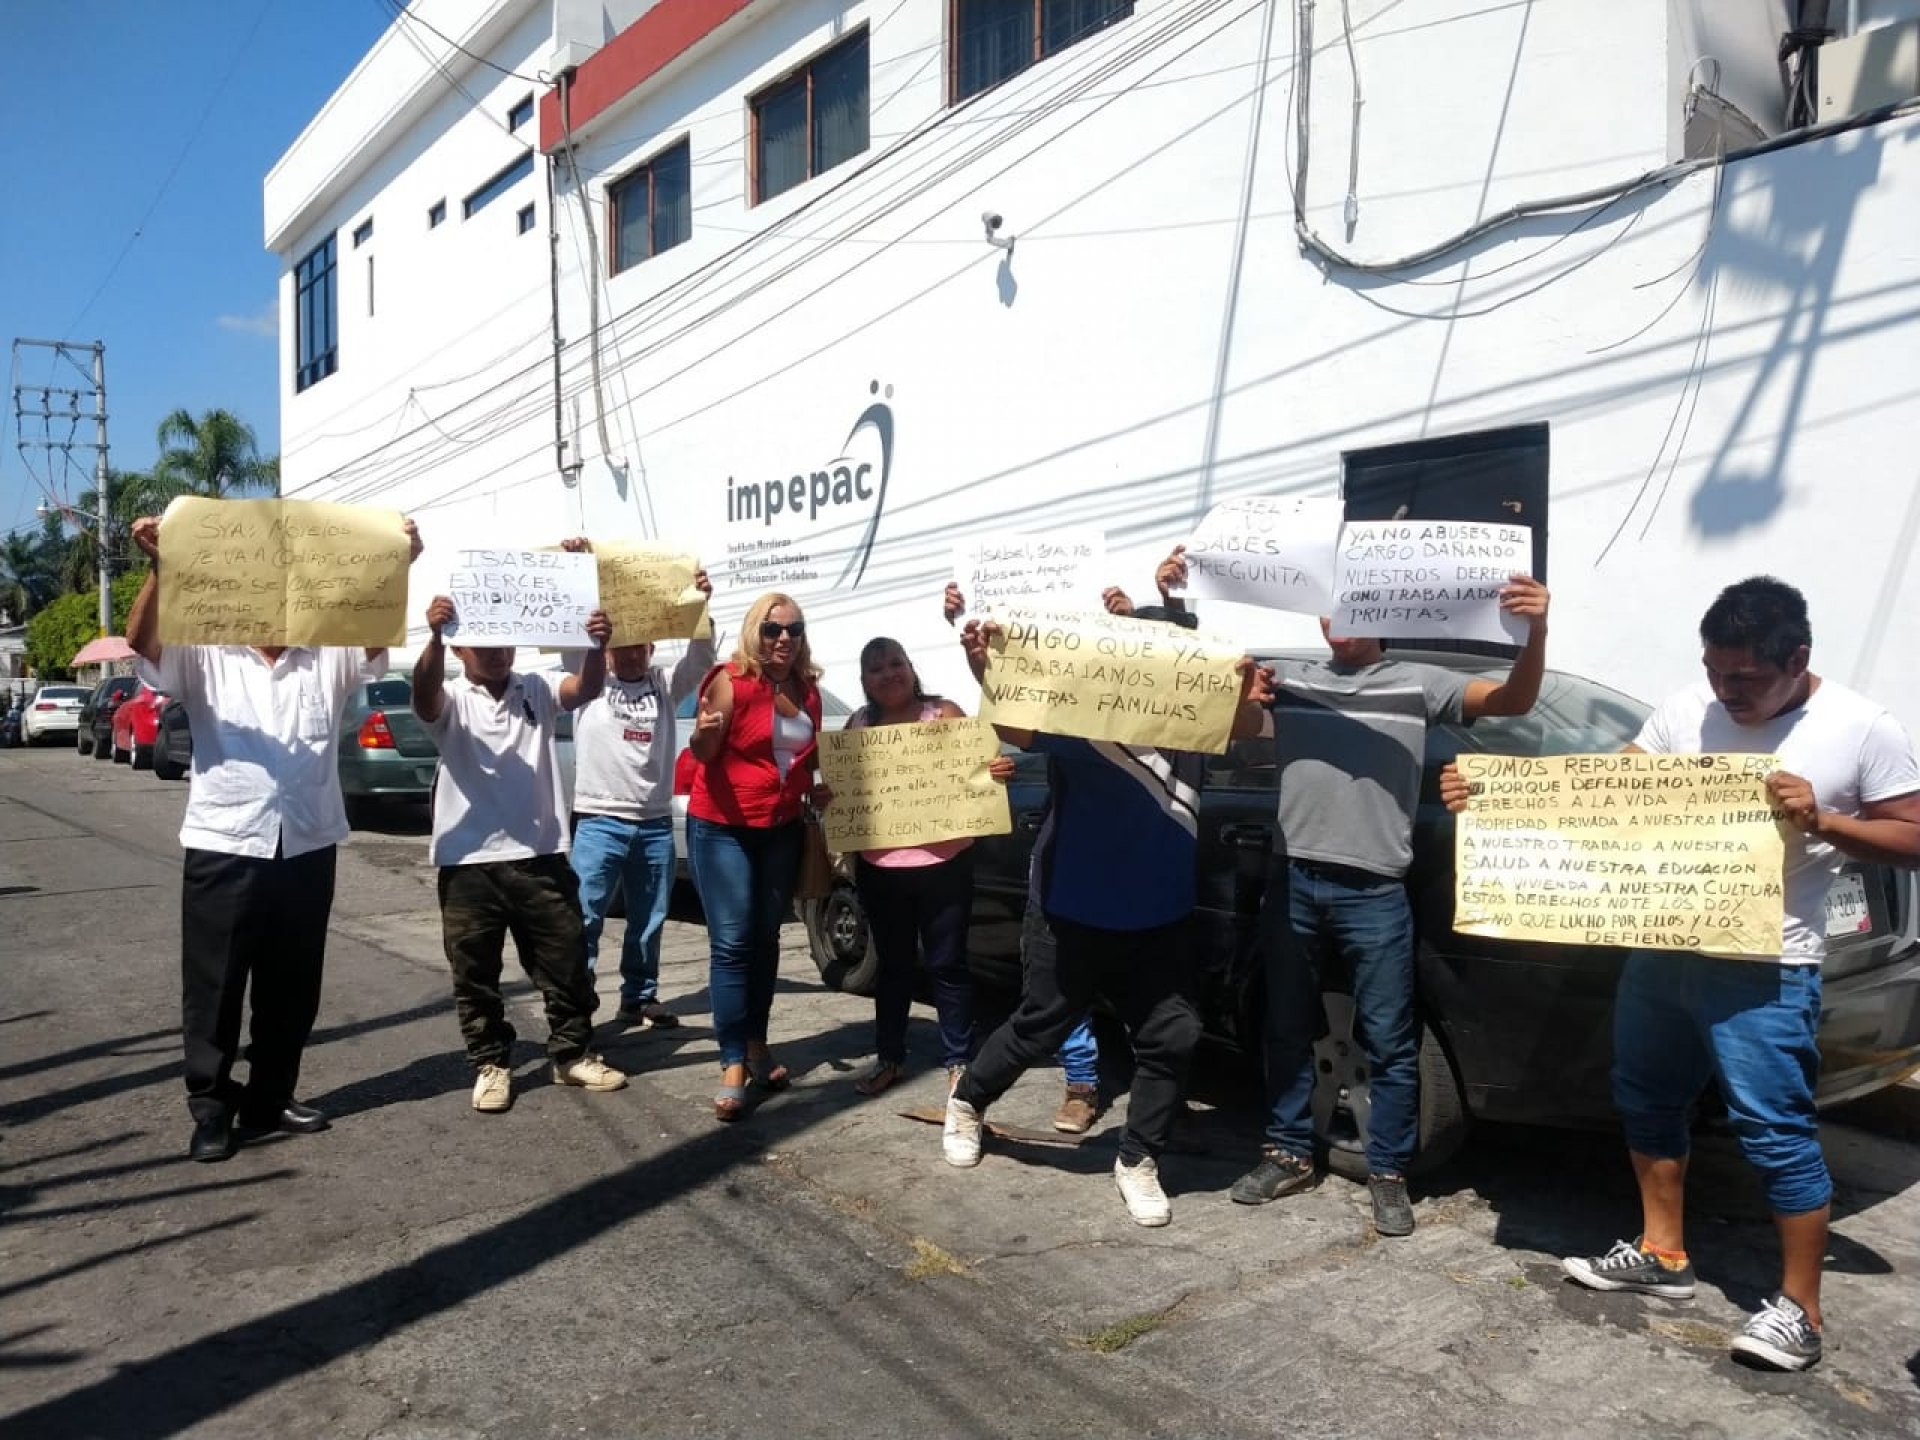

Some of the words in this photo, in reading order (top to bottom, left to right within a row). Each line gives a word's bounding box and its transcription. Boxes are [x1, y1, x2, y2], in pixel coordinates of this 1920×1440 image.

[728, 463, 873, 525] impepac
[1351, 527, 1375, 546] YA
[1382, 527, 1411, 540] NO
[1419, 525, 1491, 541] ABUSES
[1498, 528, 1525, 544] DEL
[1345, 544, 1414, 561] CARGO
[1423, 541, 1516, 558] DAÑANDO
[450, 573, 557, 591] EJERCES
[1345, 567, 1441, 585] NUESTROS
[1340, 588, 1381, 604] COMO
[464, 606, 499, 617] QUE
[521, 605, 553, 617] NO
[458, 621, 587, 636] ORRESPONDEN
[1007, 621, 1081, 650] PAGO
[1096, 636, 1154, 660] QUE
[1173, 644, 1209, 667] YA
[992, 655, 1156, 688] TRABAJAMOS
[1175, 670, 1235, 694] PARA
[992, 682, 1080, 708] NUESTRAS
[860, 729, 902, 747] DOLIA
[958, 720, 982, 731] MIS
[902, 742, 943, 757] AHORA
[1467, 757, 1548, 778] SOMOS
[1490, 780, 1561, 796] PORQUE
[1571, 776, 1693, 791] DEFENDEMOS
[1467, 796, 1559, 812] DERECHOS
[1571, 794, 1583, 808] A
[1591, 794, 1616, 808] LA
[1625, 794, 1667, 806] VIDA
[1684, 791, 1698, 811] A
[828, 824, 883, 839] ISABEL
[889, 821, 922, 838] LEON
[1558, 815, 1618, 829] PRIVADA
[1628, 815, 1638, 826] A
[1643, 813, 1715, 826] NUESTRA
[1463, 837, 1475, 849] A
[1481, 838, 1559, 850] NUESTRO
[1563, 839, 1642, 851] TRABAJO
[1653, 840, 1664, 851] A
[1672, 840, 1749, 852] NUESTRA
[1463, 854, 1530, 870] SALUD
[1539, 857, 1550, 869] A
[1559, 858, 1646, 875] NUESTRA
[1658, 861, 1756, 875] EDUCACION
[1462, 876, 1473, 888] A
[1480, 876, 1503, 889] LA
[1514, 877, 1588, 890] VIVIENDA
[1599, 881, 1611, 894] A
[1620, 881, 1698, 895] NUESTRA
[1703, 879, 1782, 897] CULTURA
[1463, 890, 1506, 904] ESTOS
[1515, 893, 1600, 909] DERECHOS
[1660, 898, 1695, 910] LOS
[1704, 897, 1746, 915] DOY
[1520, 912, 1557, 929] QUE
[1559, 914, 1606, 929] LUCHO
[1612, 914, 1637, 929] POR
[1643, 914, 1684, 928] ELLOS
[1690, 914, 1701, 933] Y
[1705, 914, 1744, 928] LOS
[1585, 931, 1700, 946] DEFIENDO
